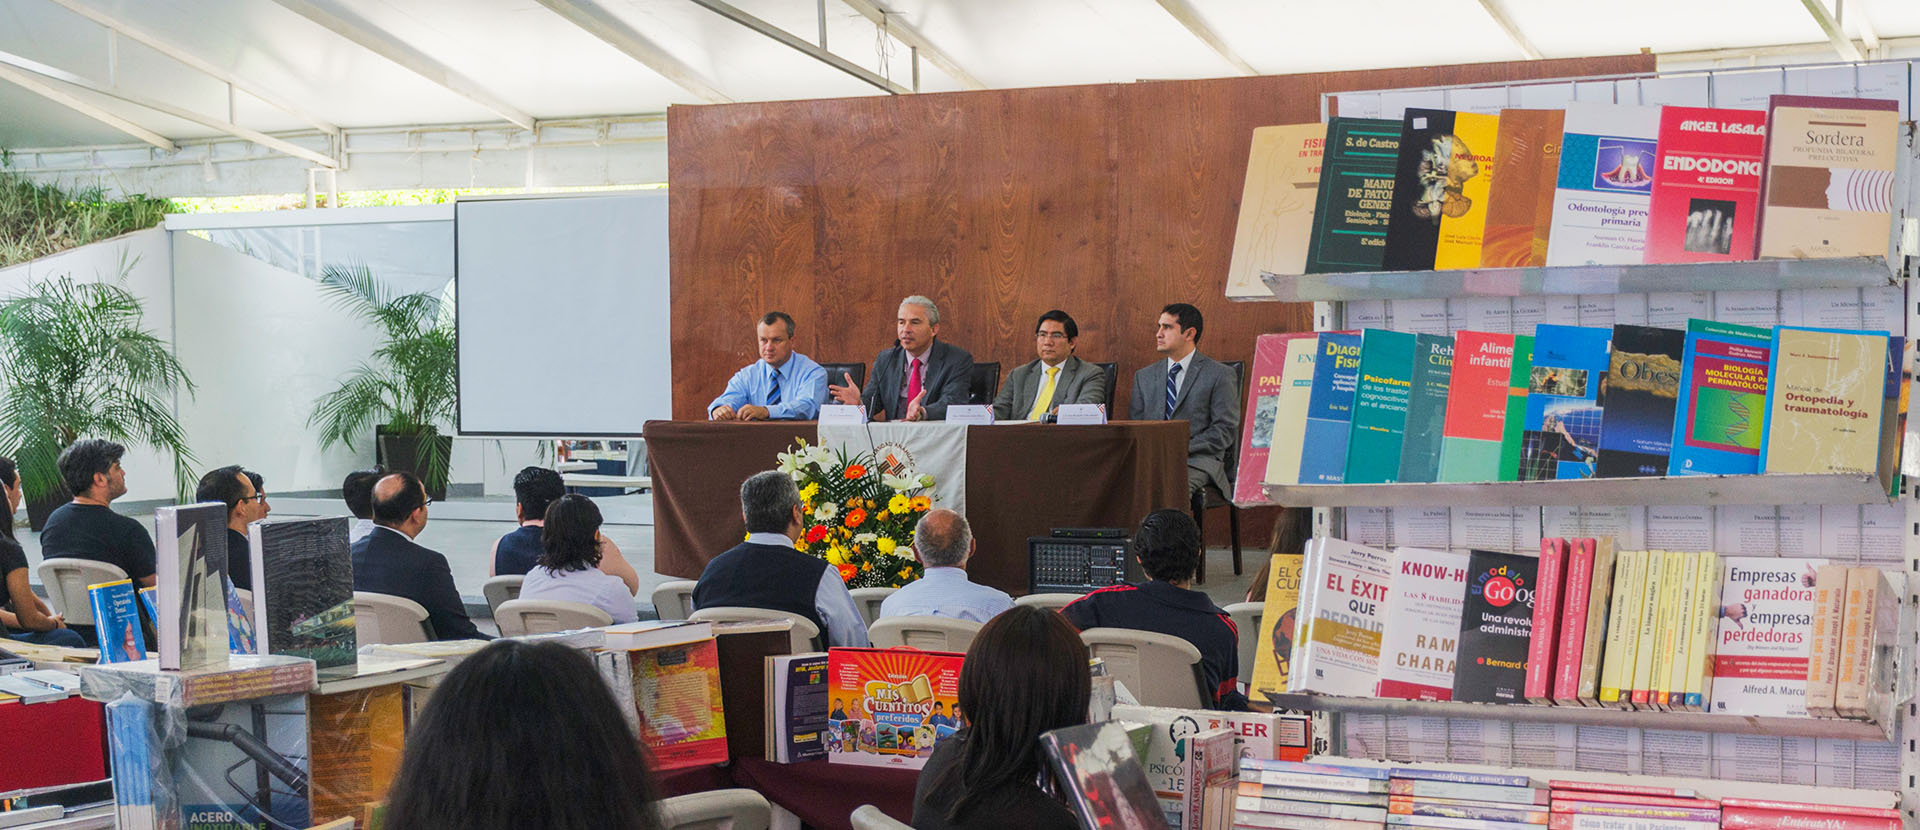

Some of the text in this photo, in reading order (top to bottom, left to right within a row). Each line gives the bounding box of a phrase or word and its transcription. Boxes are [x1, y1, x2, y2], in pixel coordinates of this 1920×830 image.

[1680, 120, 1766, 136] ANGEL LASALA
[1346, 137, 1399, 149] S. de Castro
[1806, 130, 1864, 146] Sordera
[1348, 188, 1362, 198] DE
[1568, 202, 1626, 217] Odontología
[1601, 216, 1641, 227] primaria
[1705, 368, 1756, 382] MOLECULAR
[1724, 364, 1764, 376] BIOLOGÍA
[1786, 392, 1854, 408] Ortopedia y
[1784, 403, 1868, 420] traumatología
[1350, 548, 1366, 558] Jerry
[1326, 574, 1344, 592] EL
[1730, 567, 1796, 586] Empresas
[1351, 574, 1388, 602] ÉXIT
[1421, 592, 1427, 600] 8
[1348, 600, 1376, 616] QUE
[1752, 604, 1756, 612] y
[1482, 612, 1502, 622] Una
[1723, 628, 1803, 645] perdedoras
[1416, 634, 1456, 653] RAM
[1486, 658, 1521, 670] Bernard
[1743, 684, 1768, 696] Alfred
[1769, 686, 1778, 695] A.
[876, 712, 920, 724] preferidos
[190, 812, 233, 824] ACERO
